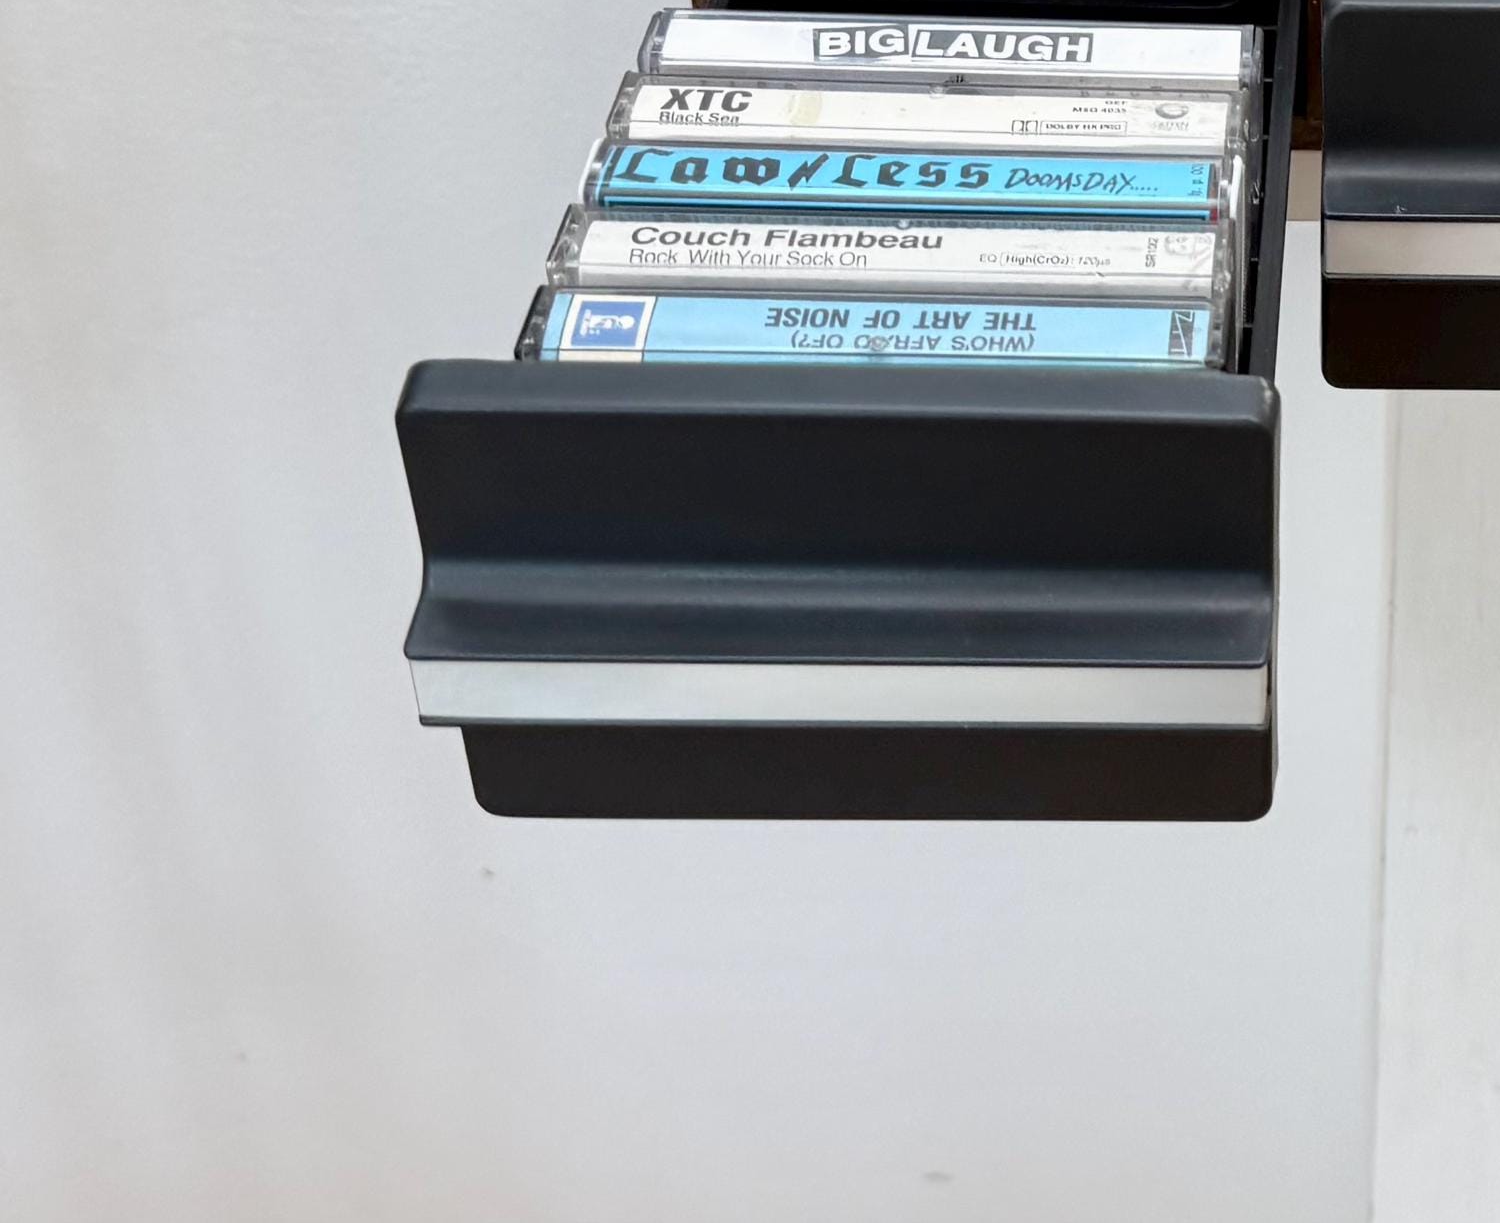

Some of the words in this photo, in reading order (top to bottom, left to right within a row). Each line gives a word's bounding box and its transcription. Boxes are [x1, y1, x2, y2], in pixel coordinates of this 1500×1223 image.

[818, 28, 905, 56] BIG
[915, 31, 1090, 62] LAUGH
[660, 88, 753, 113] XTC
[658, 111, 704, 125] Black
[708, 112, 741, 126] Sea
[631, 227, 750, 247] Couch
[764, 229, 943, 249] Flambeau
[629, 248, 678, 266] Rock
[689, 250, 730, 266] With
[738, 251, 782, 266] Your
[787, 251, 834, 267] Sock
[839, 251, 867, 268] On
[979, 253, 998, 263] EQ
[764, 307, 850, 328] NOISE
[863, 309, 900, 329] OF
[913, 310, 971, 329] ART
[983, 311, 1036, 331] THE
[790, 330, 844, 349] OF?)
[853, 334, 941, 351] AFRD
[951, 335, 1035, 352] (WHO'S
